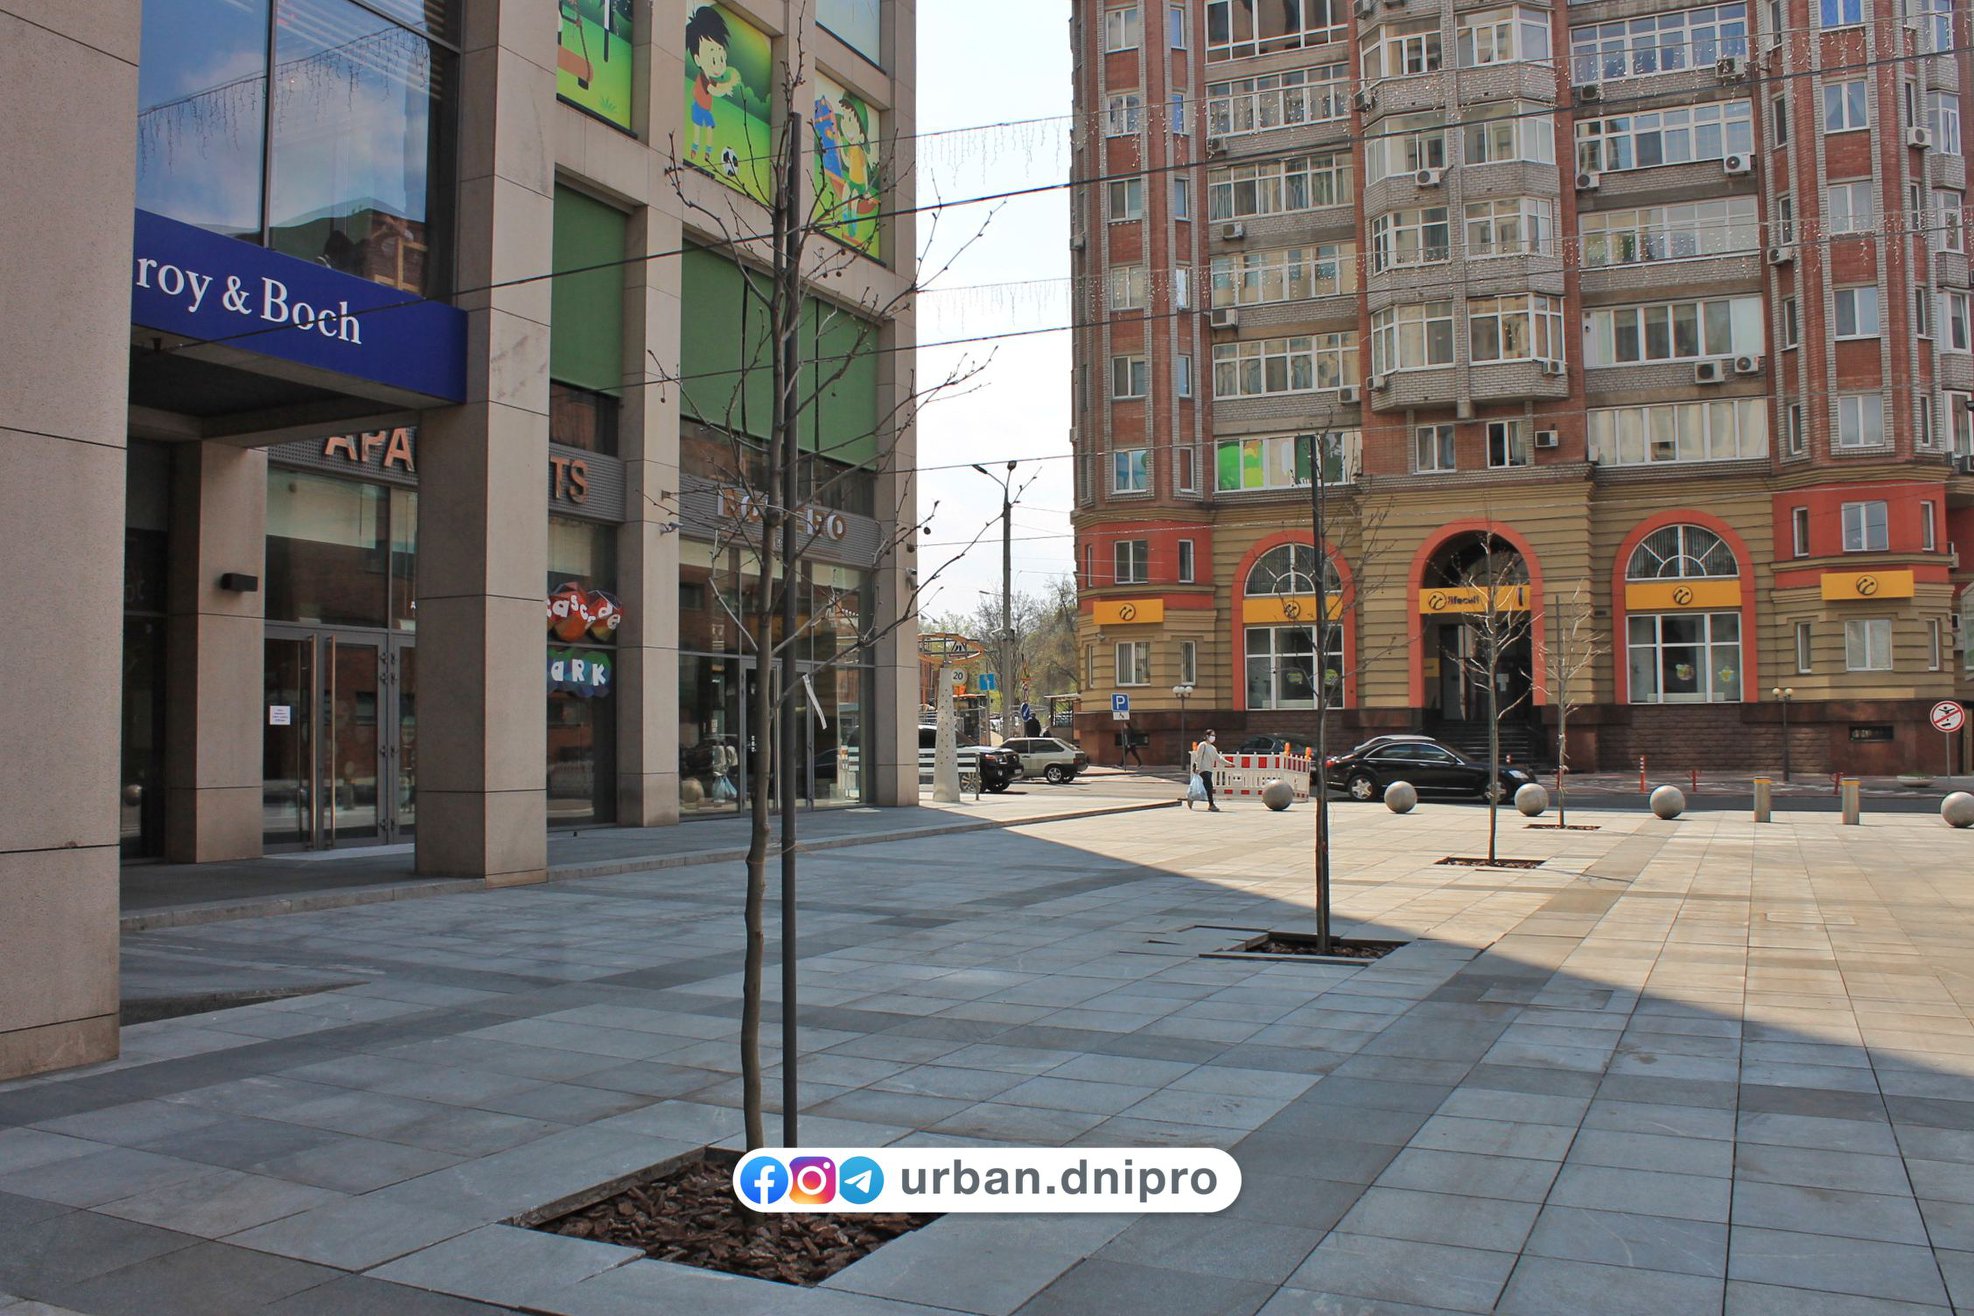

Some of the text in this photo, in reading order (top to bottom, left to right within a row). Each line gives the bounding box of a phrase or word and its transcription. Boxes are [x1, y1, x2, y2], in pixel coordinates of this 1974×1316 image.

[222, 275, 252, 315] &
[260, 276, 362, 345] Boch
[952, 671, 964, 680] 20
[1115, 695, 1126, 710] P
